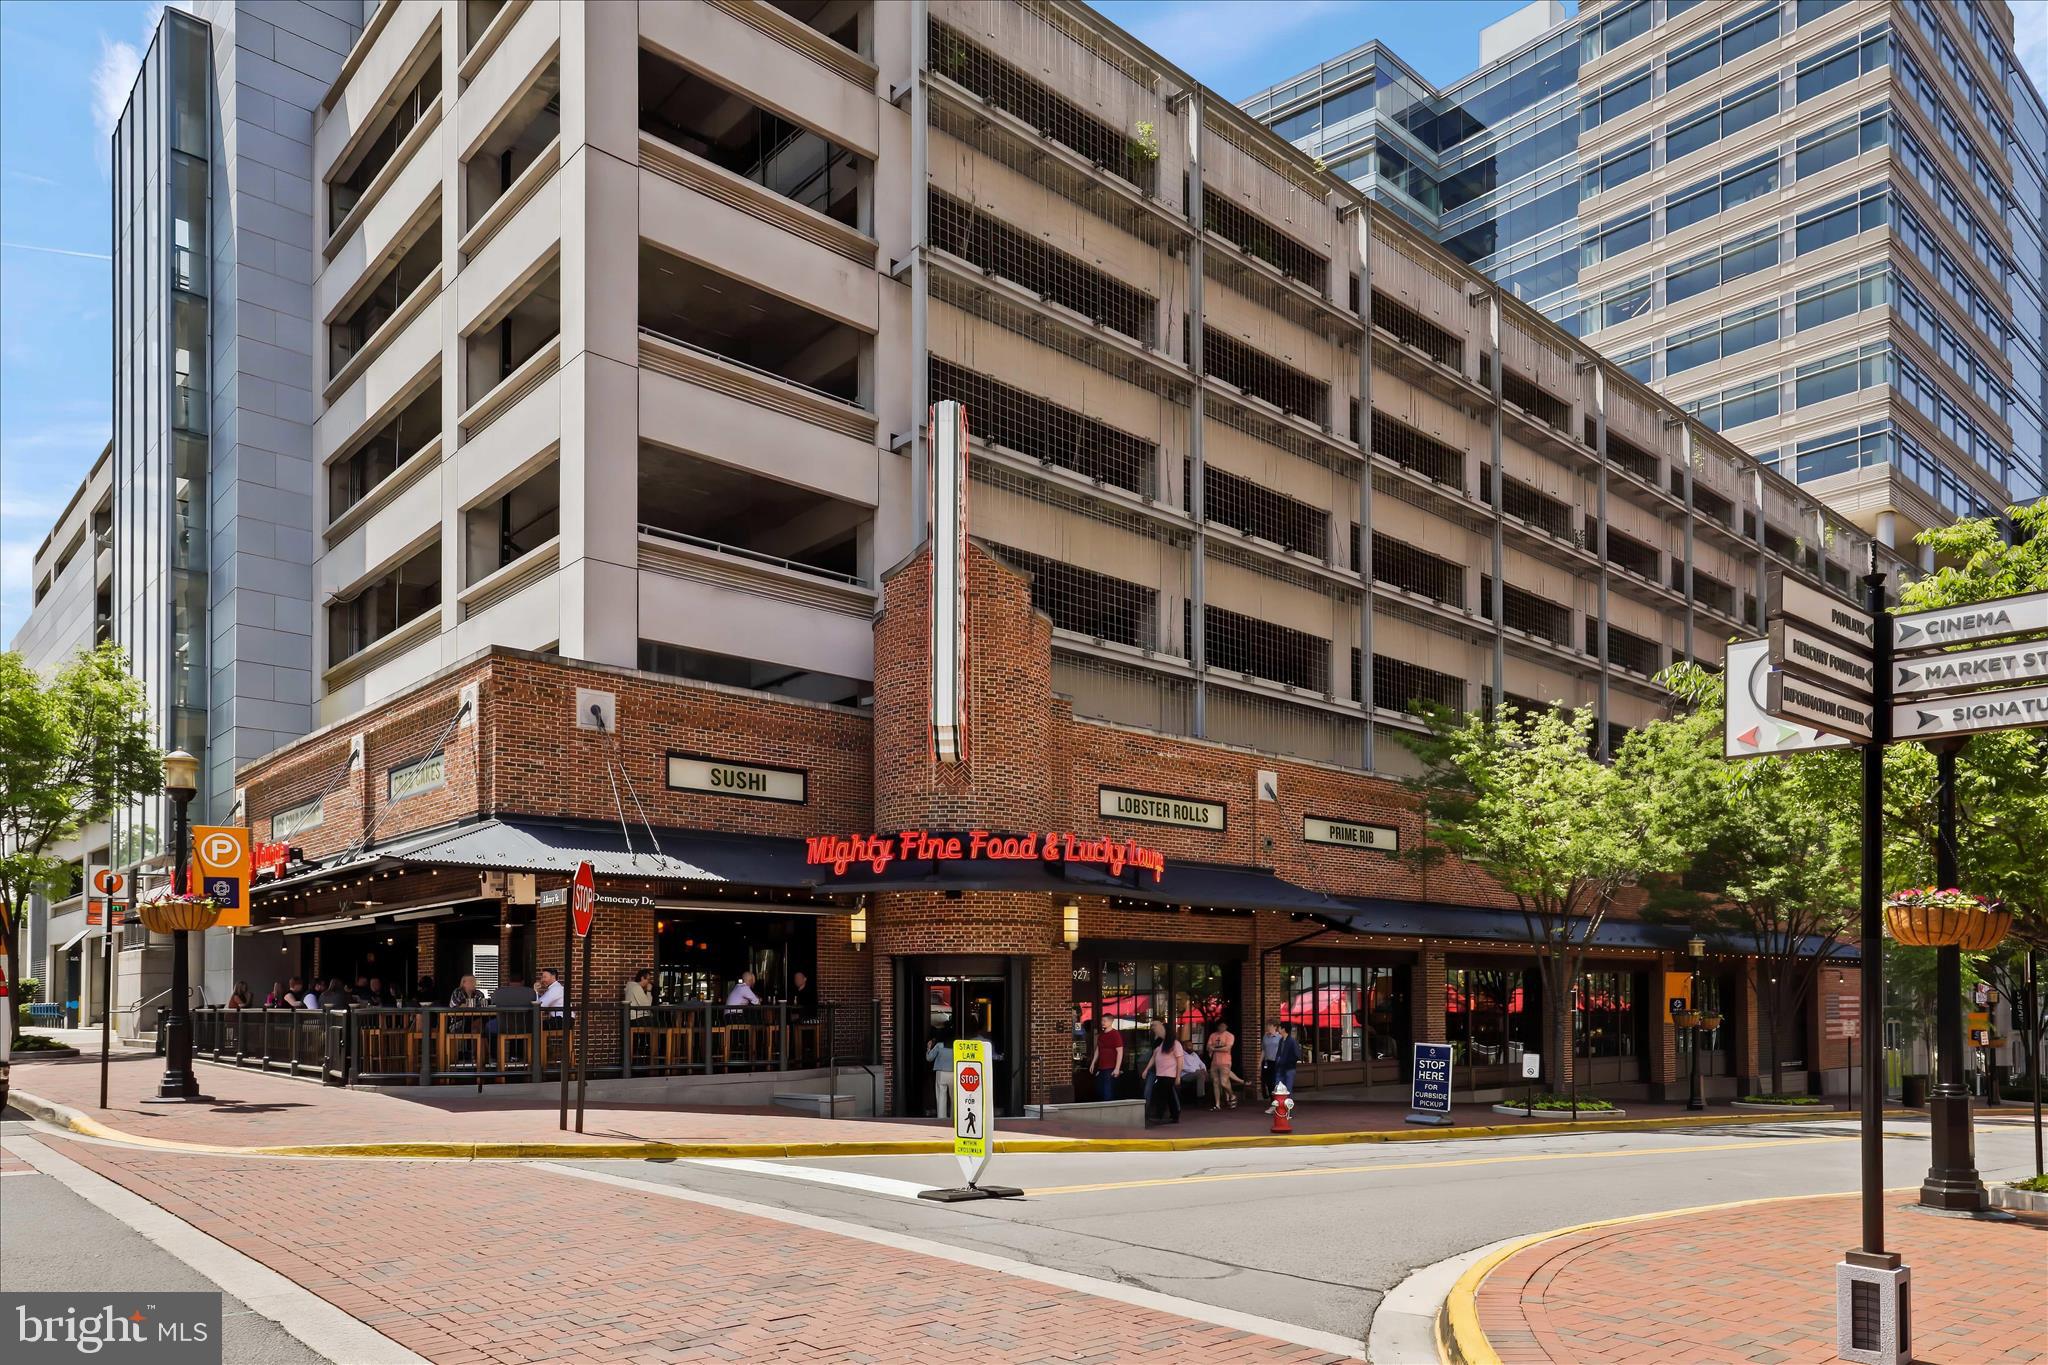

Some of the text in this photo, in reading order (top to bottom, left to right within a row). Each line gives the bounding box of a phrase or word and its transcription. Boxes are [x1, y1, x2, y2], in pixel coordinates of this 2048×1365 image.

[1831, 608, 1865, 636] PAVILION
[1925, 610, 2011, 635] CINEMA
[1793, 638, 1865, 681] MERCURY FOUNTAIN
[1925, 655, 2016, 680] MARKET
[1783, 686, 1864, 726] INFORMATION CENTER
[710, 767, 767, 792] SUSHI
[1118, 796, 1209, 823] LOBSTER ROLLS
[1329, 825, 1374, 844] PRIME RIB
[211, 839, 233, 862] P
[806, 833, 894, 875] Mighty
[900, 830, 963, 860] Fine
[969, 830, 1038, 860] Food
[1043, 831, 1060, 861] &
[1063, 832, 1126, 877] Lucky
[575, 884, 593, 913] STOP
[593, 892, 655, 907] Democracy Dr.
[1072, 970, 1088, 980] 927
[959, 1043, 978, 1051] STATE
[1418, 1070, 1445, 1081] HERE
[1419, 1060, 1446, 1070] STOP
[960, 1074, 979, 1084] STOP
[1415, 1091, 1448, 1100] CURBSIDE
[1419, 1100, 1444, 1108] PICKUP
